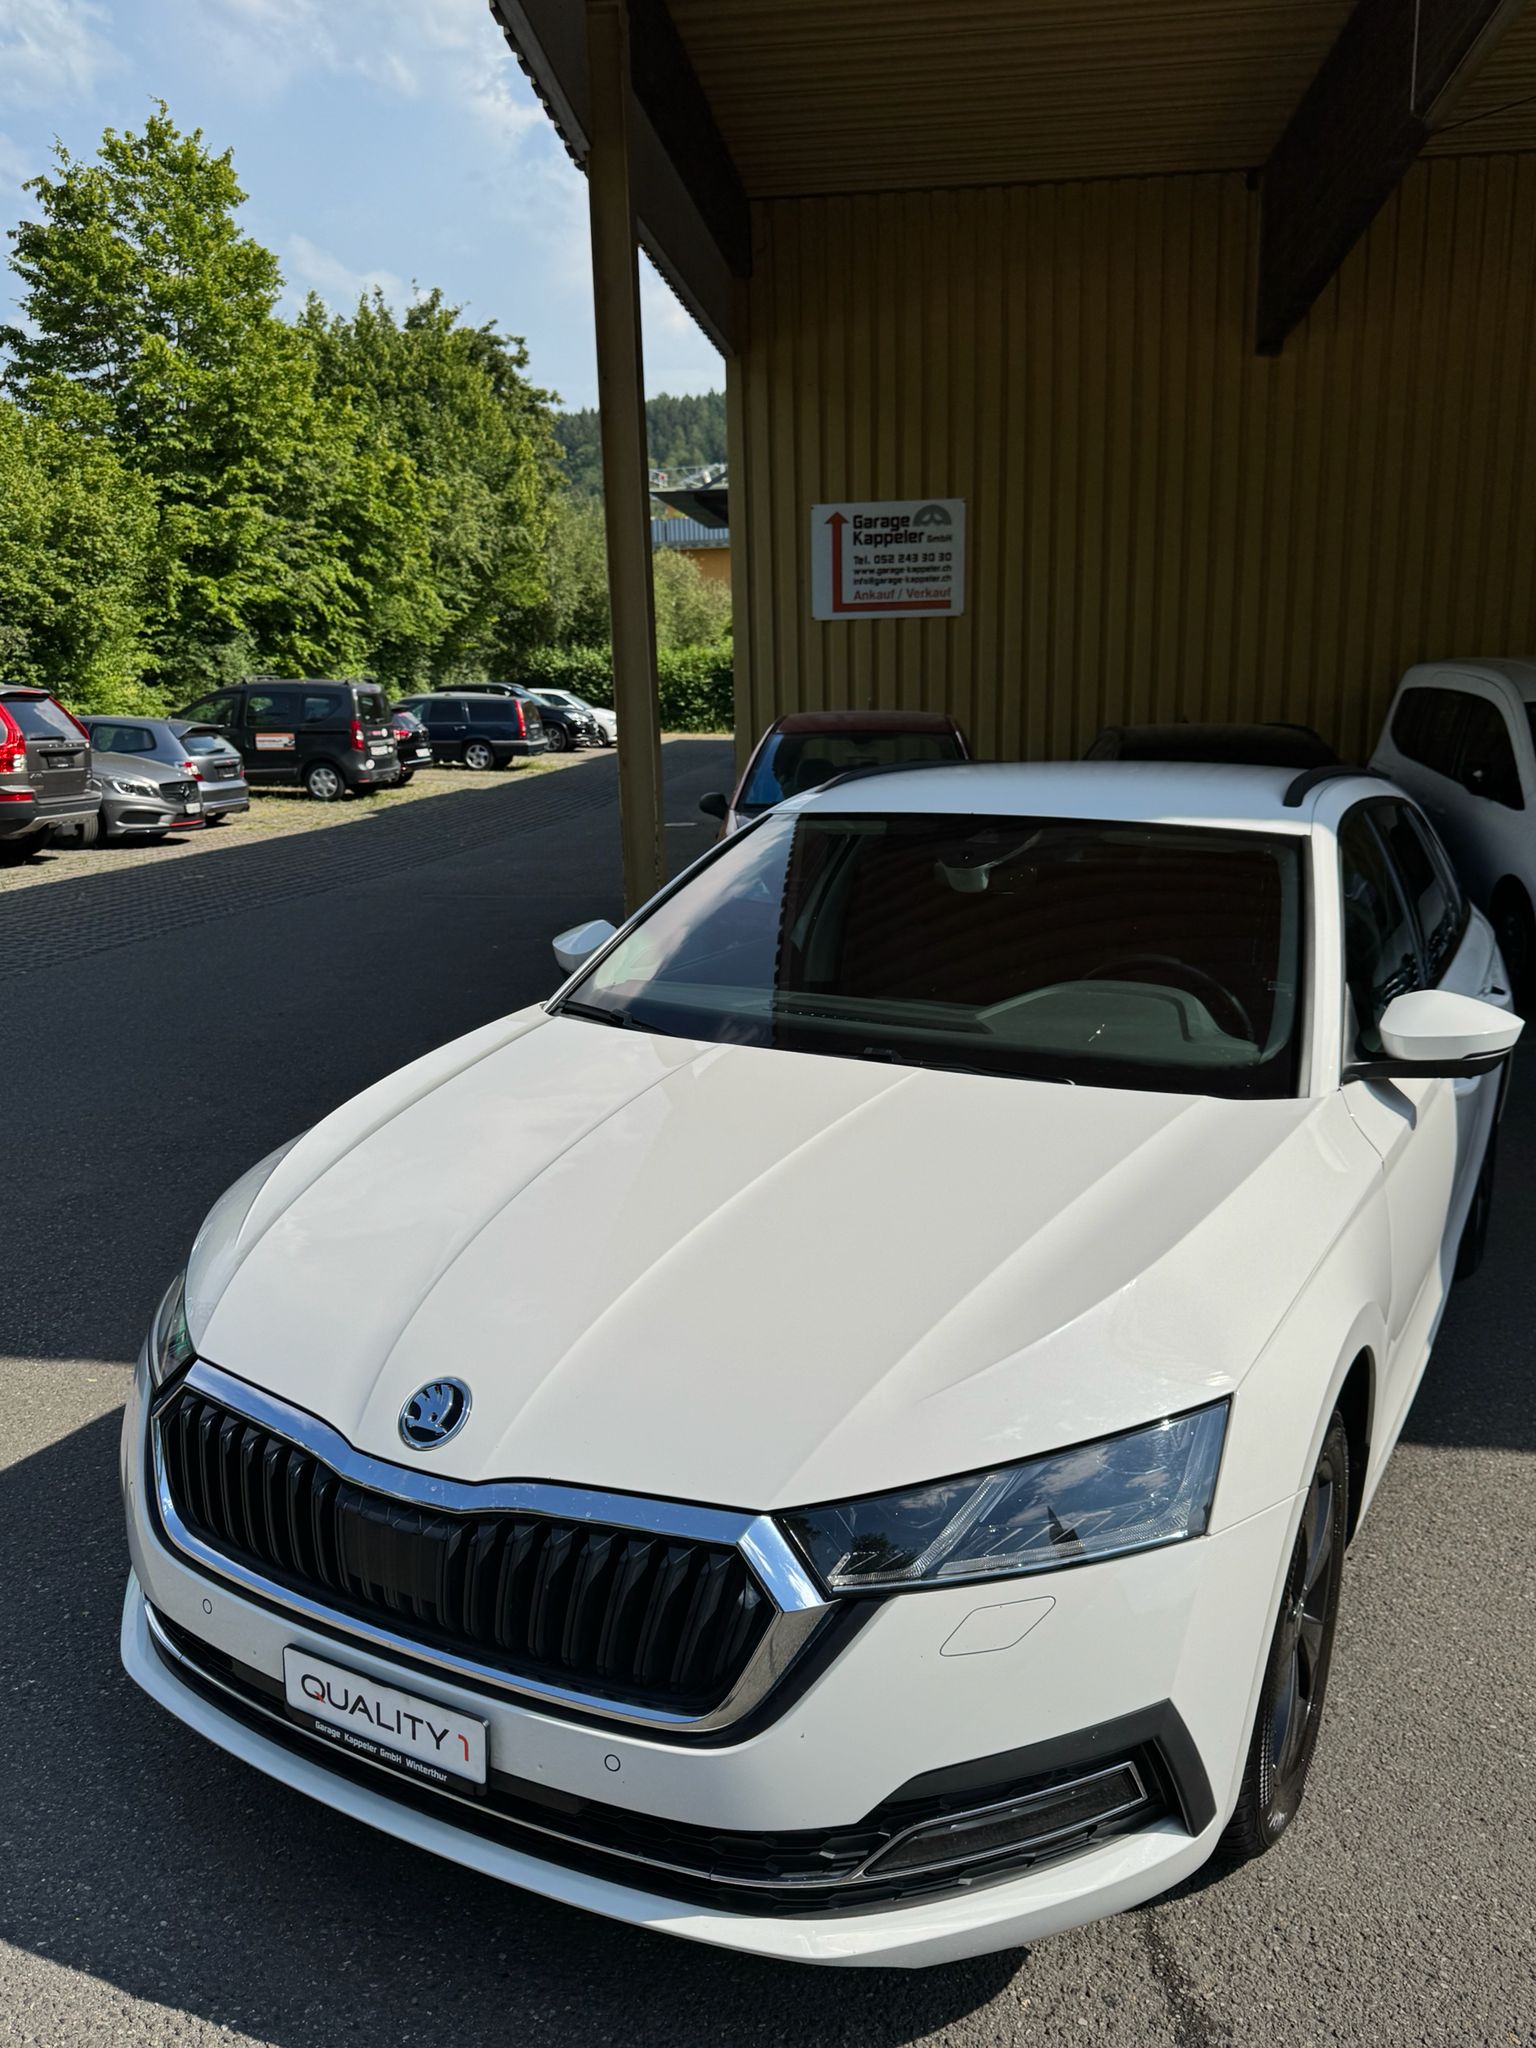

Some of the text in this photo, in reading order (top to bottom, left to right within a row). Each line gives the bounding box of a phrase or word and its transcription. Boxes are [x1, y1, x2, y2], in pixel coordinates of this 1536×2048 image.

[853, 515, 910, 532] Garage
[853, 530, 952, 548] Kappeler GmbH
[853, 552, 952, 565] Tel. 052 243 30 30
[853, 565, 952, 576] www.garage-kappeler.ch
[853, 589, 895, 600] Ankauf
[906, 587, 951, 599] Verkauf
[301, 1674, 449, 1750] QUALITY
[315, 1720, 448, 1782] Garage Kappeler GmbH Winterthur
